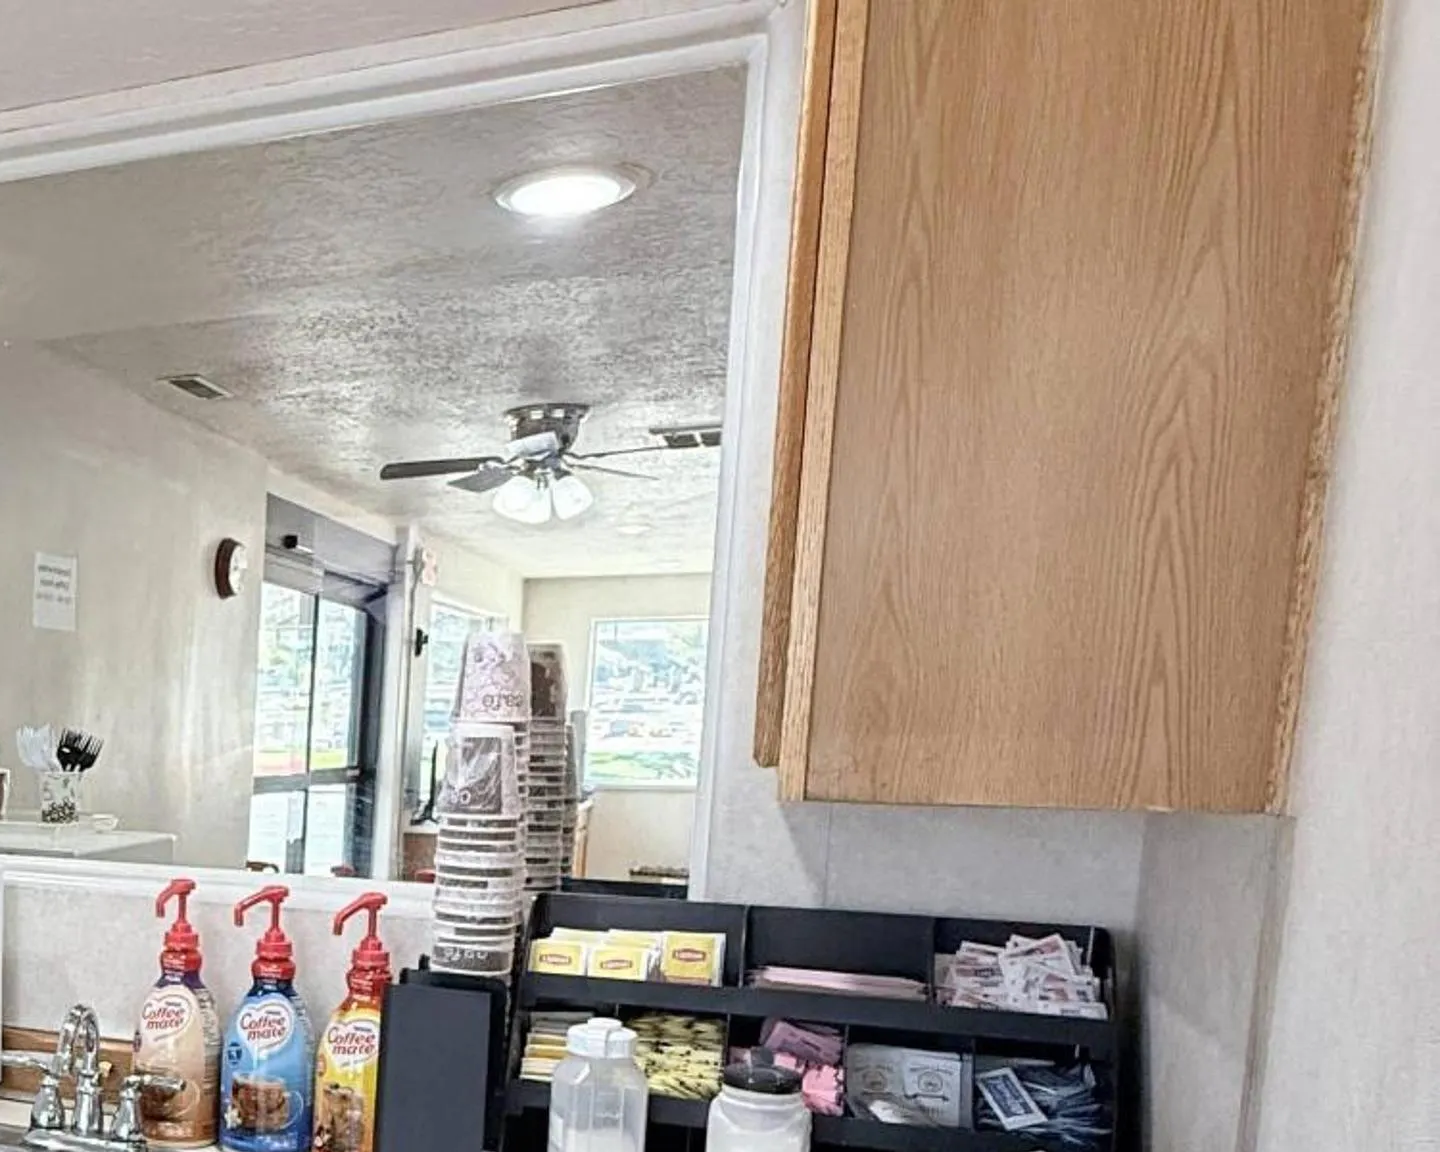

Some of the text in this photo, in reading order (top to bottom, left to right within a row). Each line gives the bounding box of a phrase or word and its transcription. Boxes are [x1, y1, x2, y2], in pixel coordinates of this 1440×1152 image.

[142, 1003, 186, 1020] Coffee
[145, 1018, 184, 1030] mate
[241, 1013, 285, 1030] Coffee
[248, 1027, 286, 1041] mate
[328, 1026, 376, 1044] Coffee
[332, 1044, 376, 1055] mate
